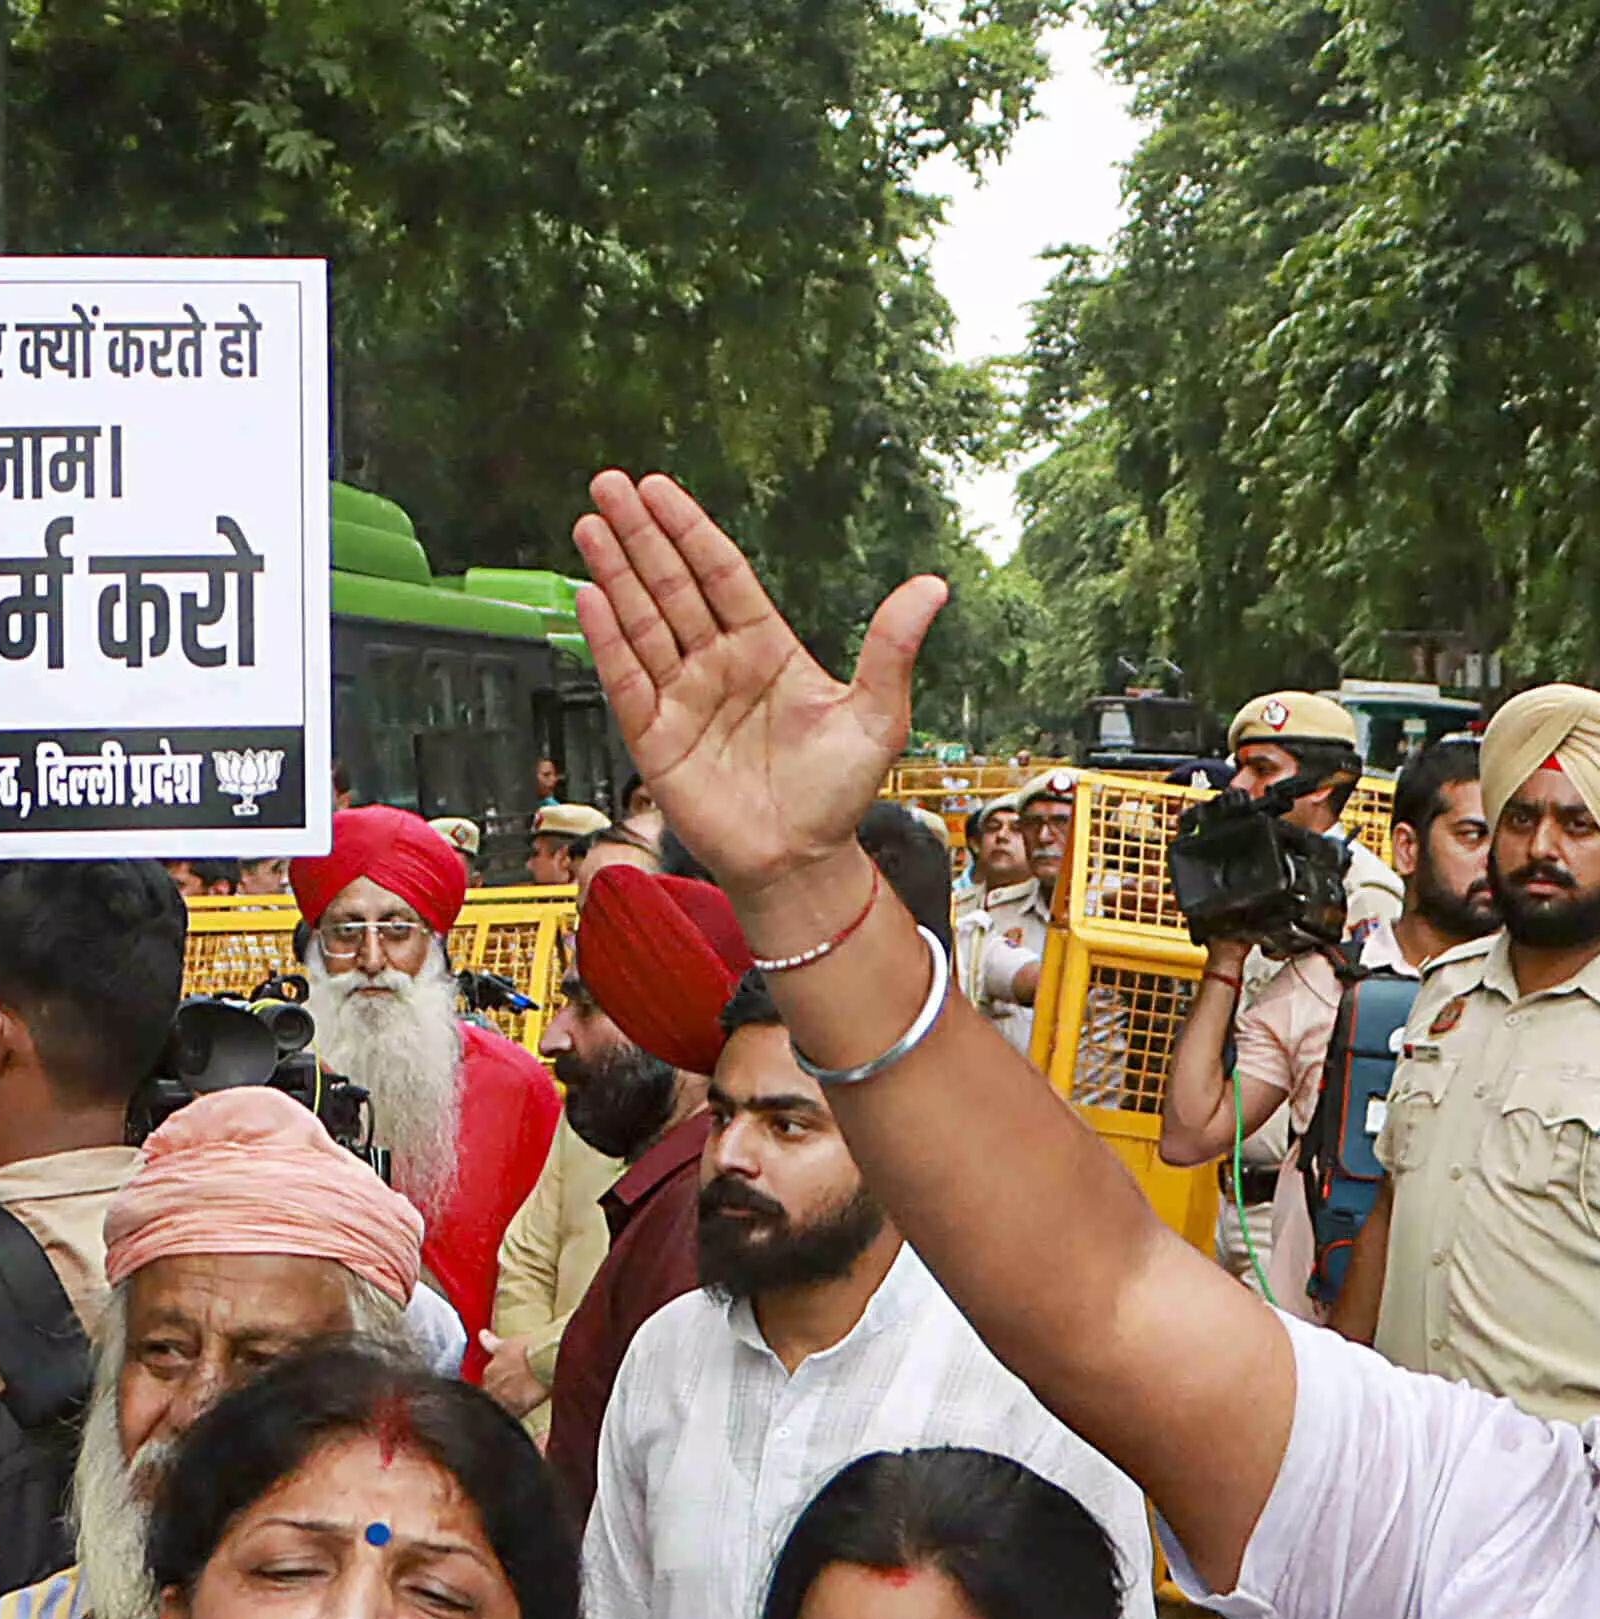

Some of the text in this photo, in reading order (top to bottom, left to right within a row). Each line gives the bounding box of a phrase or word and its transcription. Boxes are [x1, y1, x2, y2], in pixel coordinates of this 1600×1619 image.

[15, 304, 99, 378] क्यों
[104, 304, 206, 377] करते
[215, 304, 261, 377] हो
[89, 516, 264, 667] करो
[36, 741, 127, 805] दिल्ली
[129, 738, 202, 807] प्रदेश
